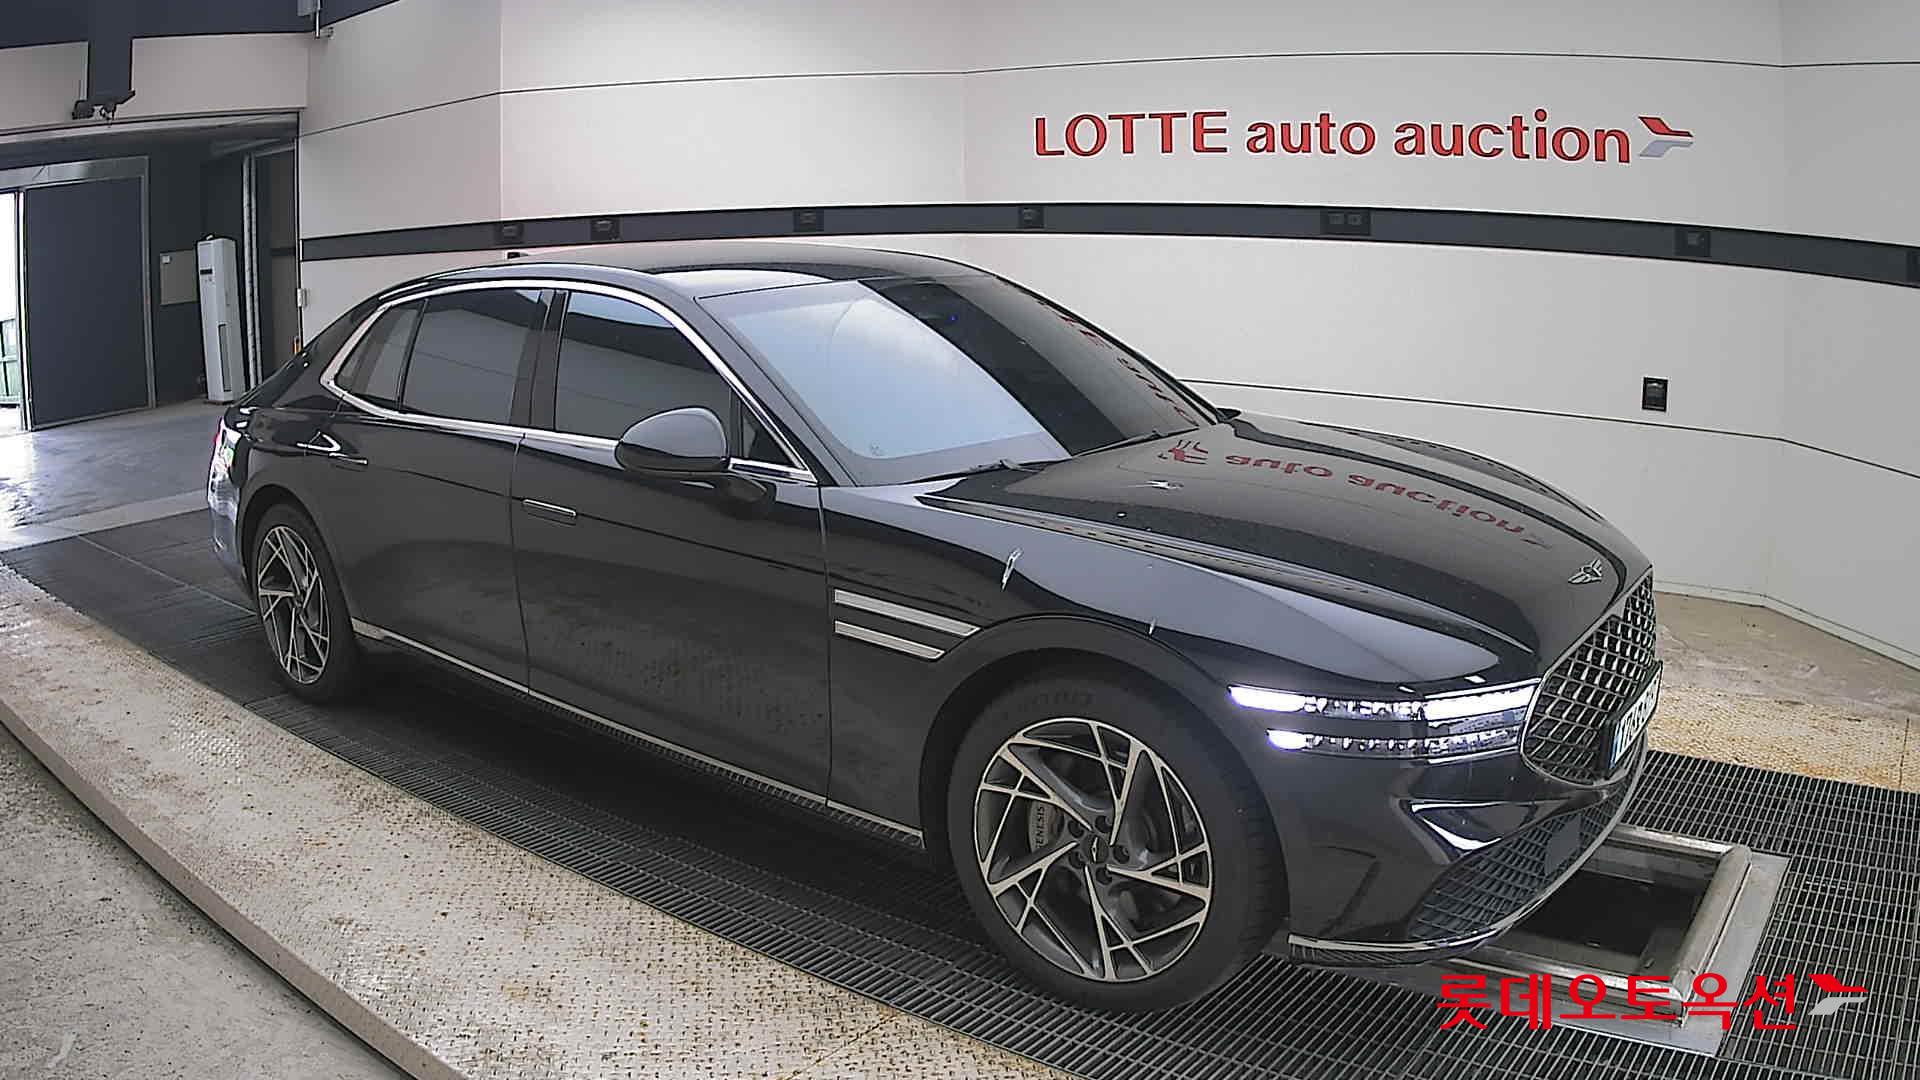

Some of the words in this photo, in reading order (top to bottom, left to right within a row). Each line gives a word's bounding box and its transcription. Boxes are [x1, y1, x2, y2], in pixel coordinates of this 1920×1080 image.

[1034, 111, 1229, 157] LOTTE
[1245, 112, 1377, 156] auto
[1393, 108, 1631, 163] auction
